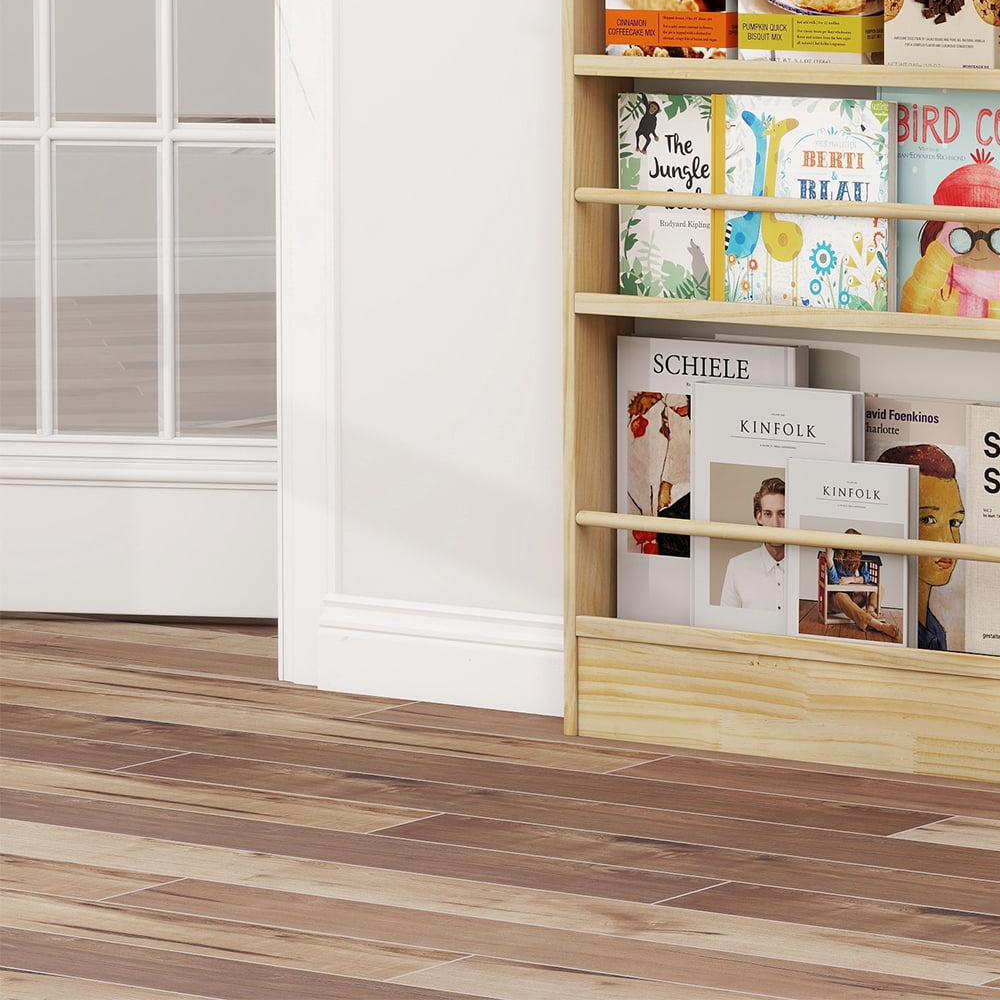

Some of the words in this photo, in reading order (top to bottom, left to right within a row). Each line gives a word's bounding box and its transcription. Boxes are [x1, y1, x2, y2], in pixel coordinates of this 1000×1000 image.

[616, 18, 647, 27] CINNAMON
[742, 23, 769, 31] PUMPKIN
[770, 24, 788, 32] QUICK
[608, 27, 643, 36] COFFEECAKE
[645, 29, 655, 37] MIX
[771, 33, 783, 41] MIX
[664, 132, 694, 156] The
[802, 150, 865, 170] BERTI
[649, 156, 711, 190] Jungle
[831, 170, 838, 181] &
[797, 178, 870, 202] BLAU
[660, 220, 687, 229] Rudyard
[688, 220, 711, 230] Kipling
[653, 353, 750, 380] SCHIELE
[865, 408, 887, 420] avid
[889, 409, 940, 424] Foenkinos
[739, 419, 817, 438] KINFOLK
[865, 421, 900, 435] harlotte
[823, 486, 881, 501] KINFOLK
